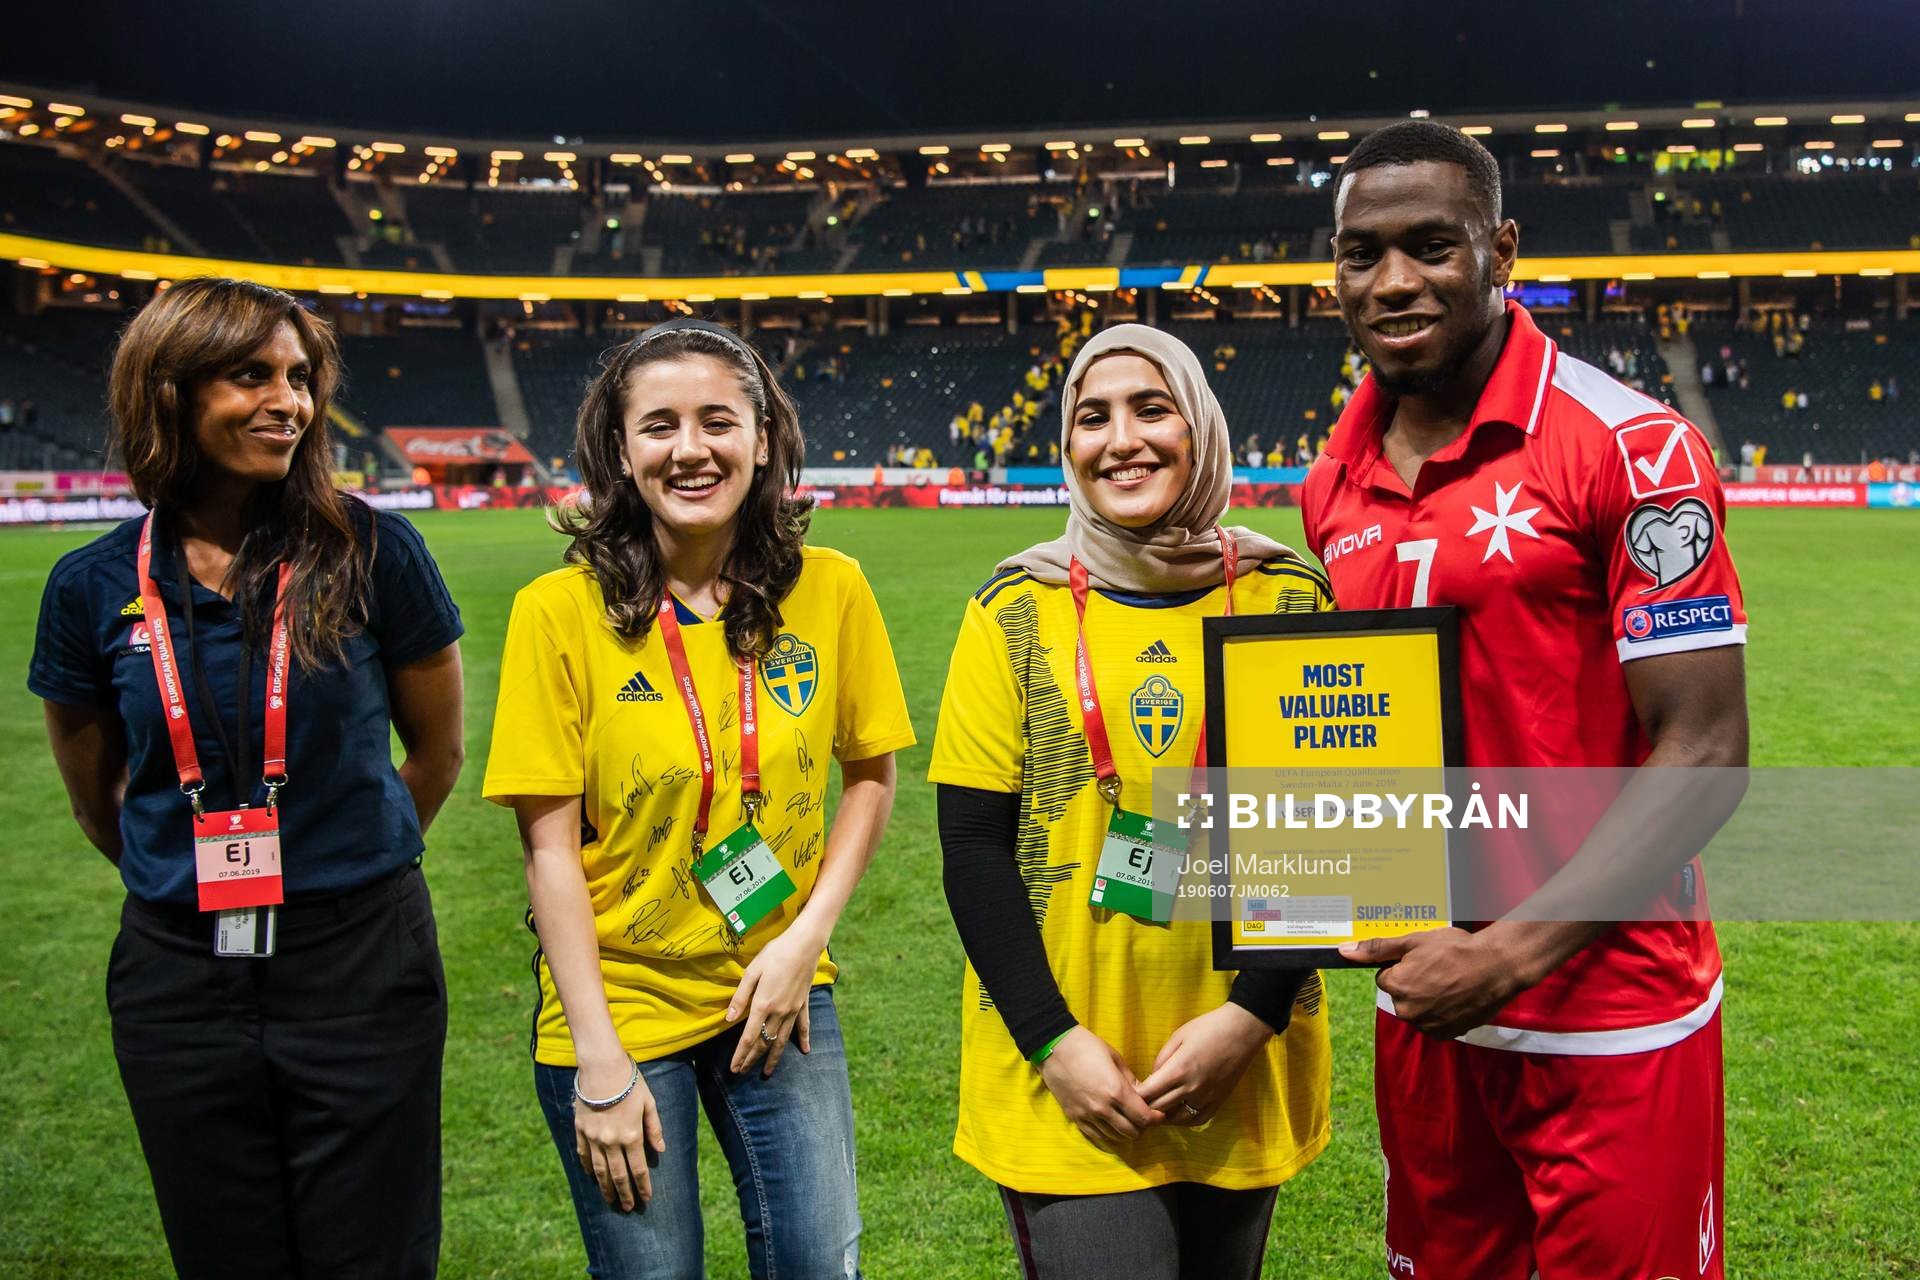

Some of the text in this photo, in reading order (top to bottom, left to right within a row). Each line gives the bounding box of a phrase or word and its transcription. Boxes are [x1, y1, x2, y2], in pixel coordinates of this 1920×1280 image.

[1324, 524, 1382, 566] GIVOVA
[1395, 538, 1438, 608] 7
[121, 607, 144, 616] adi
[1654, 605, 1731, 629] RESPECT
[152, 618, 178, 704] EUROPEAN QUALIFIERS
[770, 654, 807, 667] SVERIGE
[1135, 654, 1178, 664] adidas
[273, 650, 287, 694] EUROPEAN
[1303, 663, 1365, 688] MOST
[616, 690, 664, 702] adidas
[744, 680, 753, 721] EUROPEAN
[1140, 698, 1174, 706] SVERIGE
[1279, 693, 1391, 719] VALUABLE
[683, 675, 710, 759] EUROPEAN QUALIFIERS
[1294, 724, 1377, 749] PLAYER
[1275, 767, 1400, 779] UEFA European Qualification
[1280, 780, 1343, 789] Sweden-Malta
[1351, 780, 1373, 788] June
[1375, 779, 1397, 788] 2019
[225, 841, 251, 867] Ej
[1128, 847, 1154, 875] Ej
[219, 868, 261, 878] 07.06.2019
[728, 860, 754, 886] Ej
[1116, 872, 1156, 887] 07.06.2019
[735, 876, 767, 902] 07.06.2019
